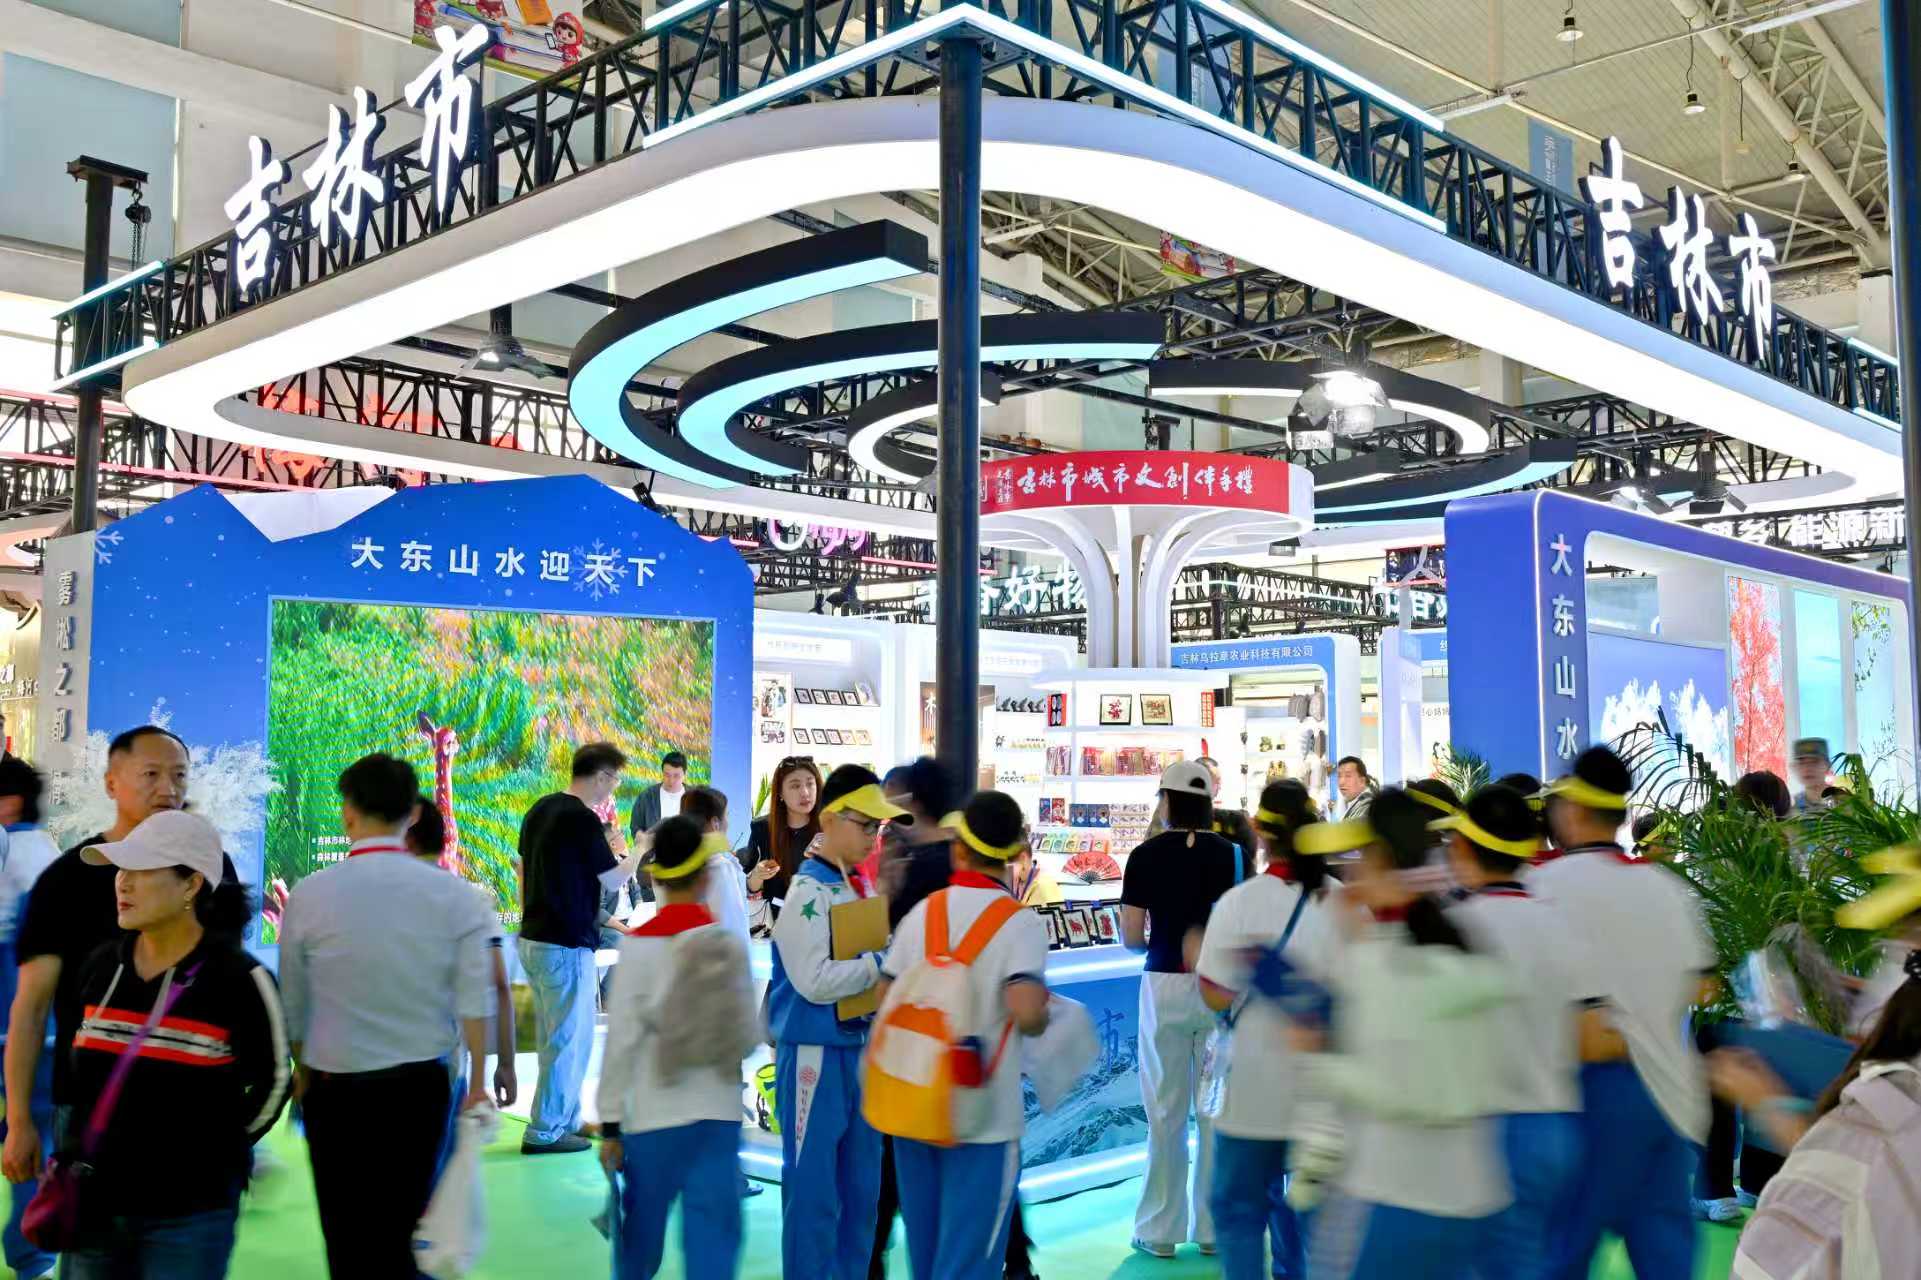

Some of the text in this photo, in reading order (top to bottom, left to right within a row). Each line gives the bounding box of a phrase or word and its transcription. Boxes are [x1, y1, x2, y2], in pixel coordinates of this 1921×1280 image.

[223, 23, 490, 293] 吉林市
[1586, 135, 1777, 362] 吉林市
[350, 536, 658, 587] 大东山水迎天下
[1549, 532, 1579, 761] 大东山水
